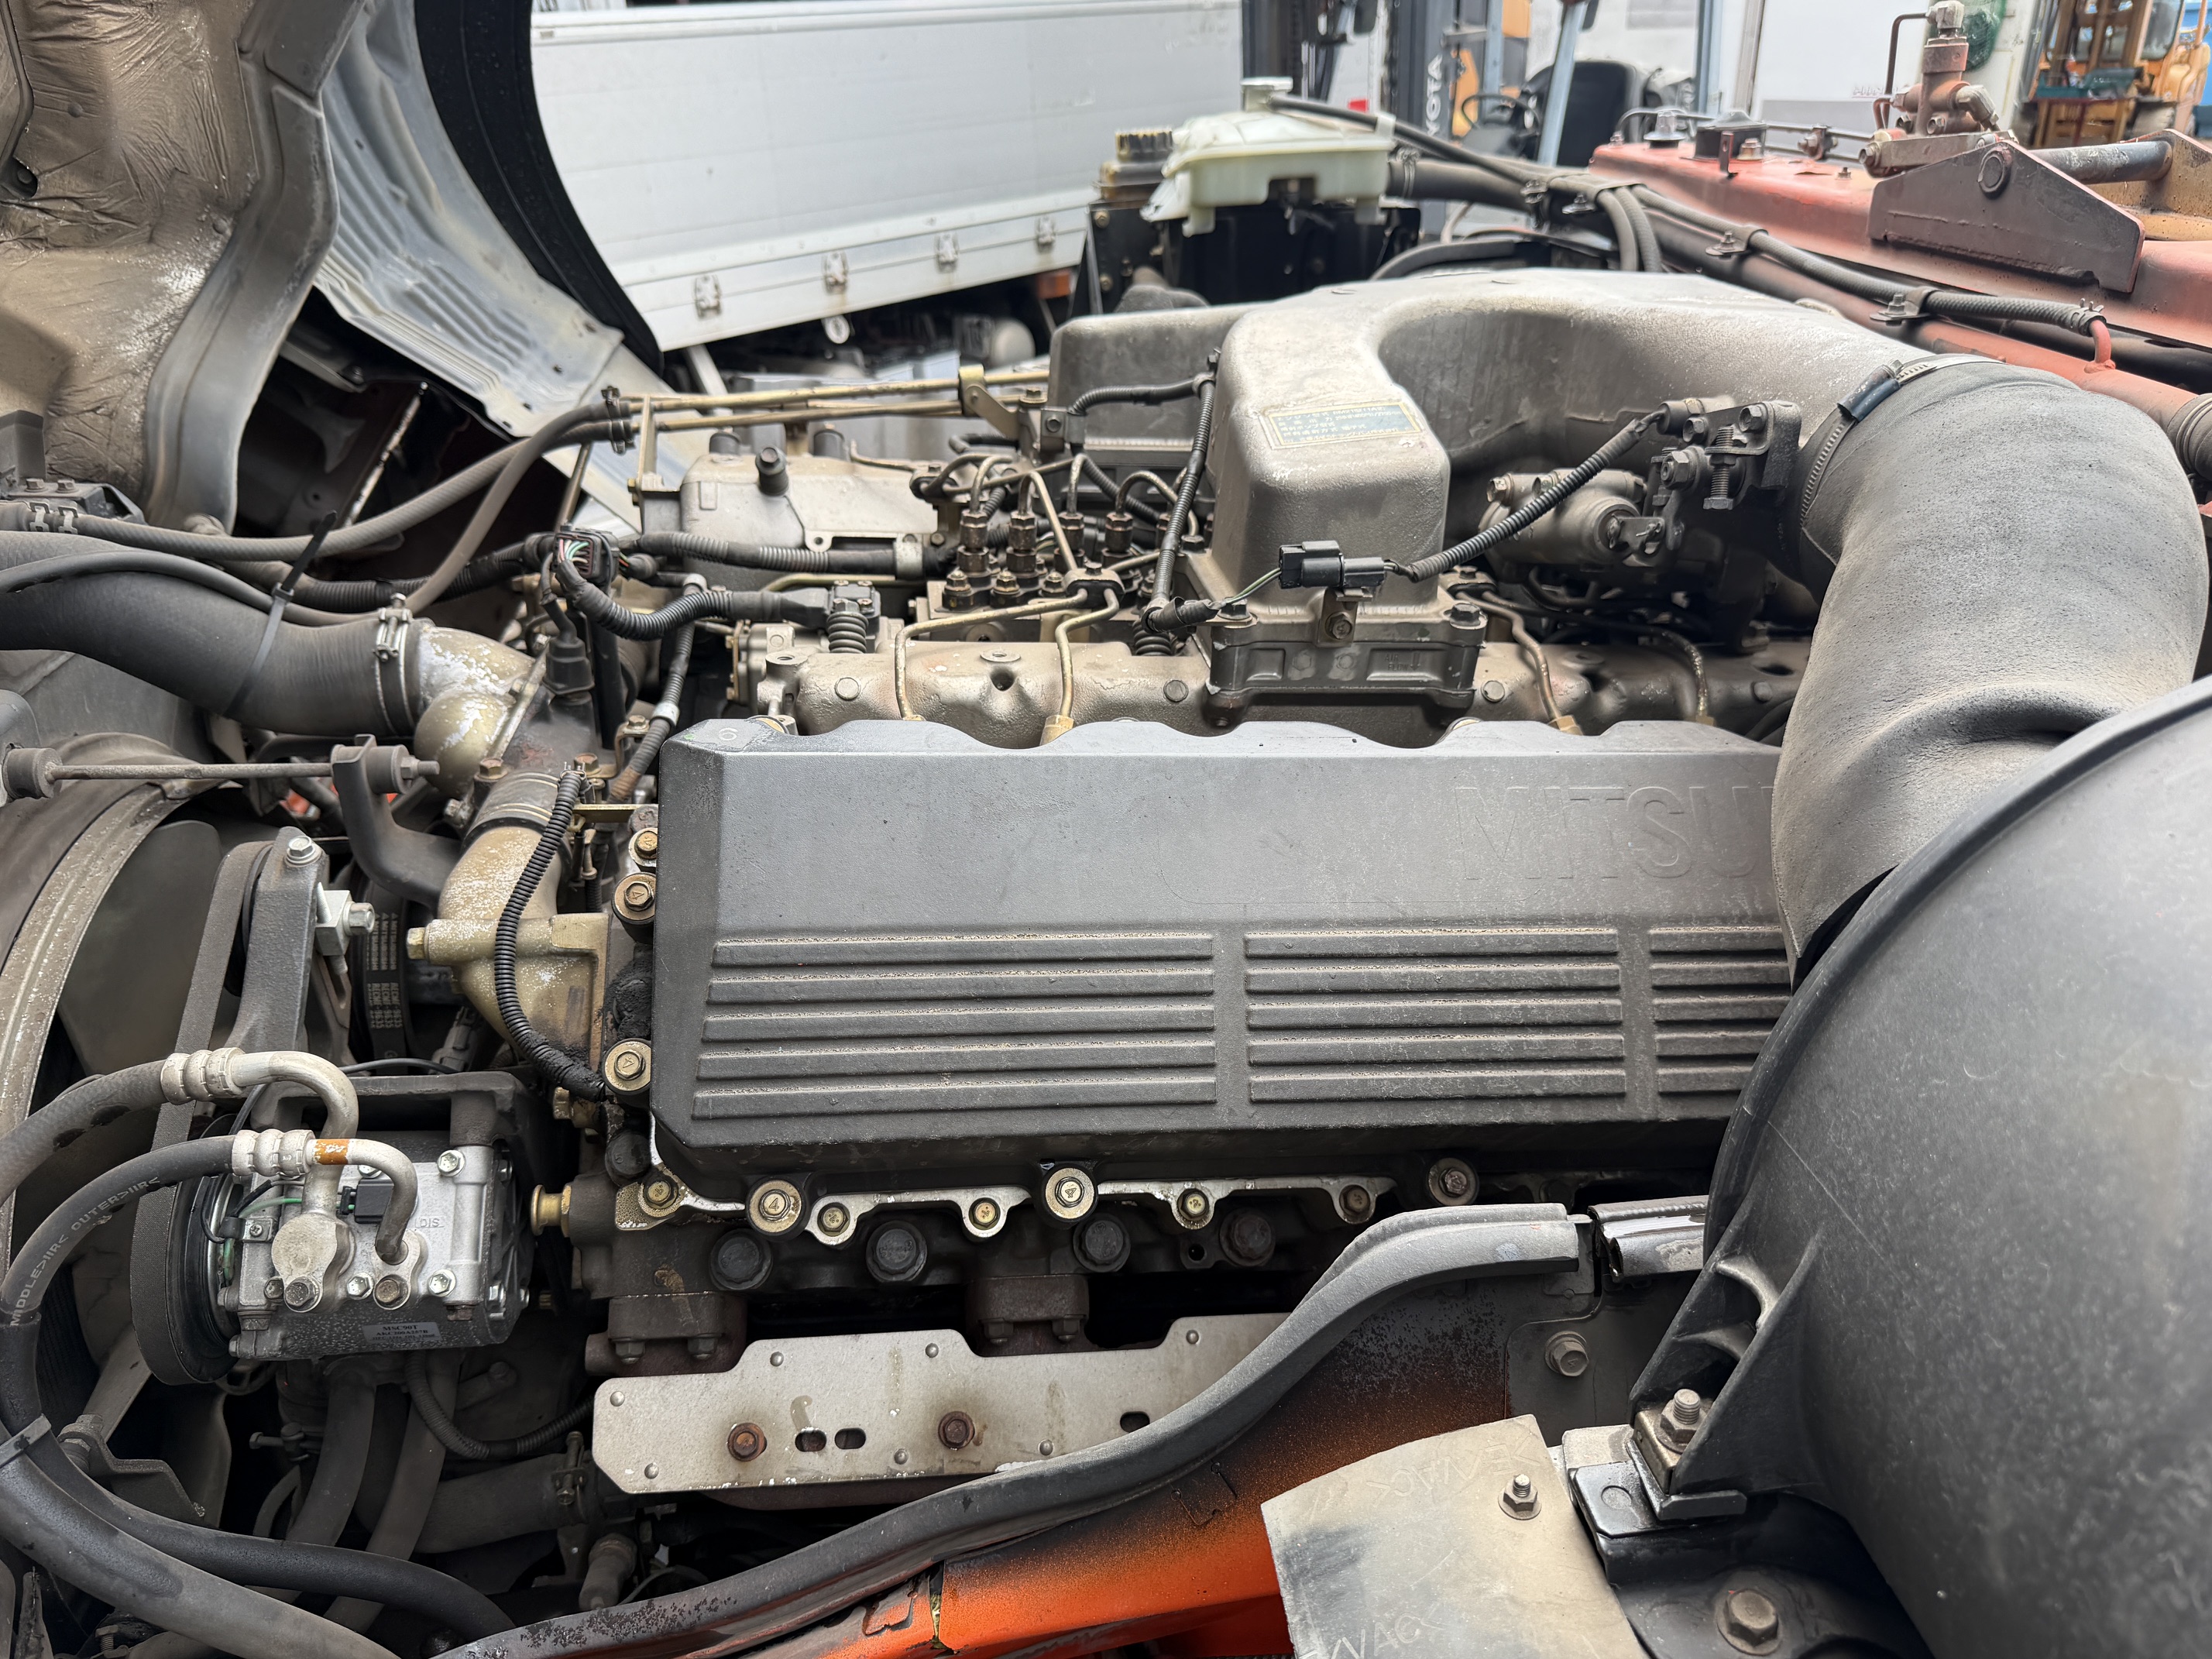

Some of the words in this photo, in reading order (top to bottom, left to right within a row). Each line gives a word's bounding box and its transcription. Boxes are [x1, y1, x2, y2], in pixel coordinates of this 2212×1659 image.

[1384, 653, 1399, 661] AIR
[1388, 663, 1410, 672] FLOW
[1455, 786, 1774, 880] MITSU
[420, 1218, 440, 1228] DIS
